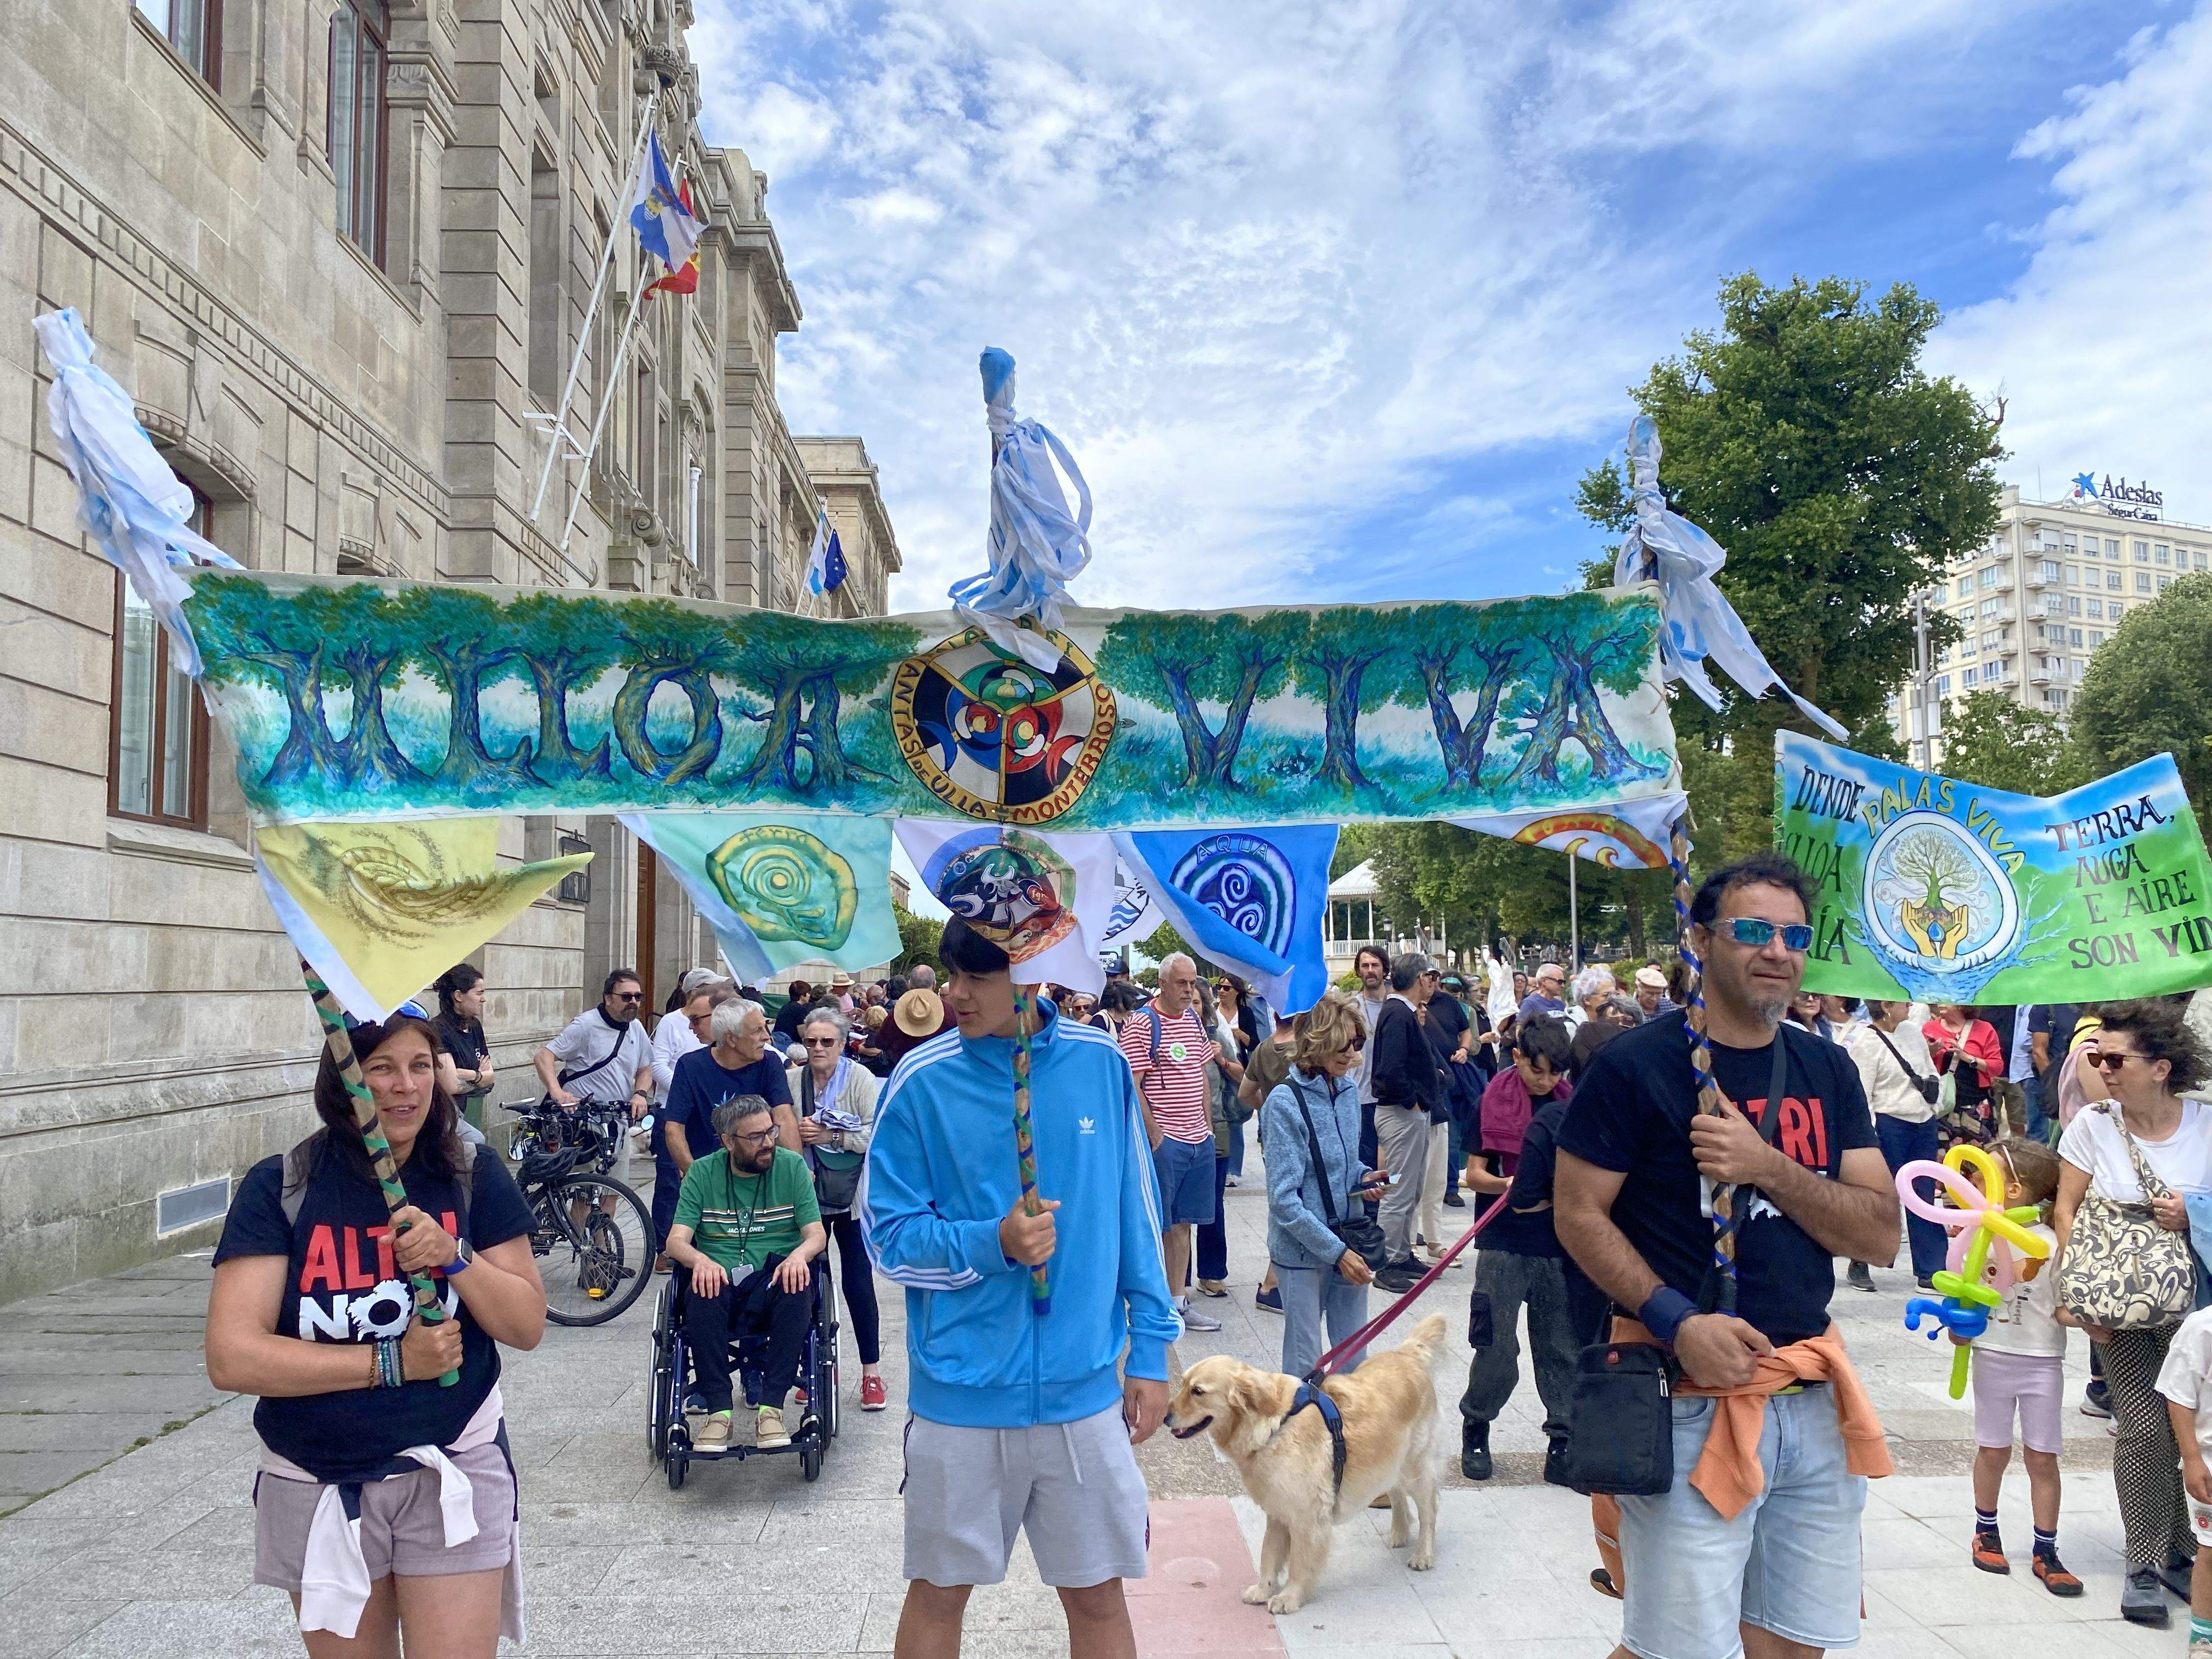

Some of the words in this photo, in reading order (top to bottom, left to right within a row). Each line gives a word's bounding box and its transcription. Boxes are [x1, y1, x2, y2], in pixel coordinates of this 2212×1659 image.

[2100, 473, 2163, 505] Adeslas
[894, 663, 922, 754] ANTAS
[911, 758, 930, 781] DE
[930, 774, 987, 817] ULLA
[1155, 635, 1660, 791] VIVA
[1791, 764, 1866, 823] DENDE
[1197, 834, 1269, 865] AQUA
[1861, 776, 1955, 839] PALAS
[1966, 798, 2026, 874] VIVA
[2045, 794, 2175, 853] TERRA,
[2074, 843, 2151, 888] AUGA
[1806, 905, 1852, 966] ÍA
[2083, 893, 2108, 924] E
[2068, 932, 2140, 970] SON
[300, 1211, 458, 1293] ALT
[727, 1226, 765, 1234] JAC&ONES
